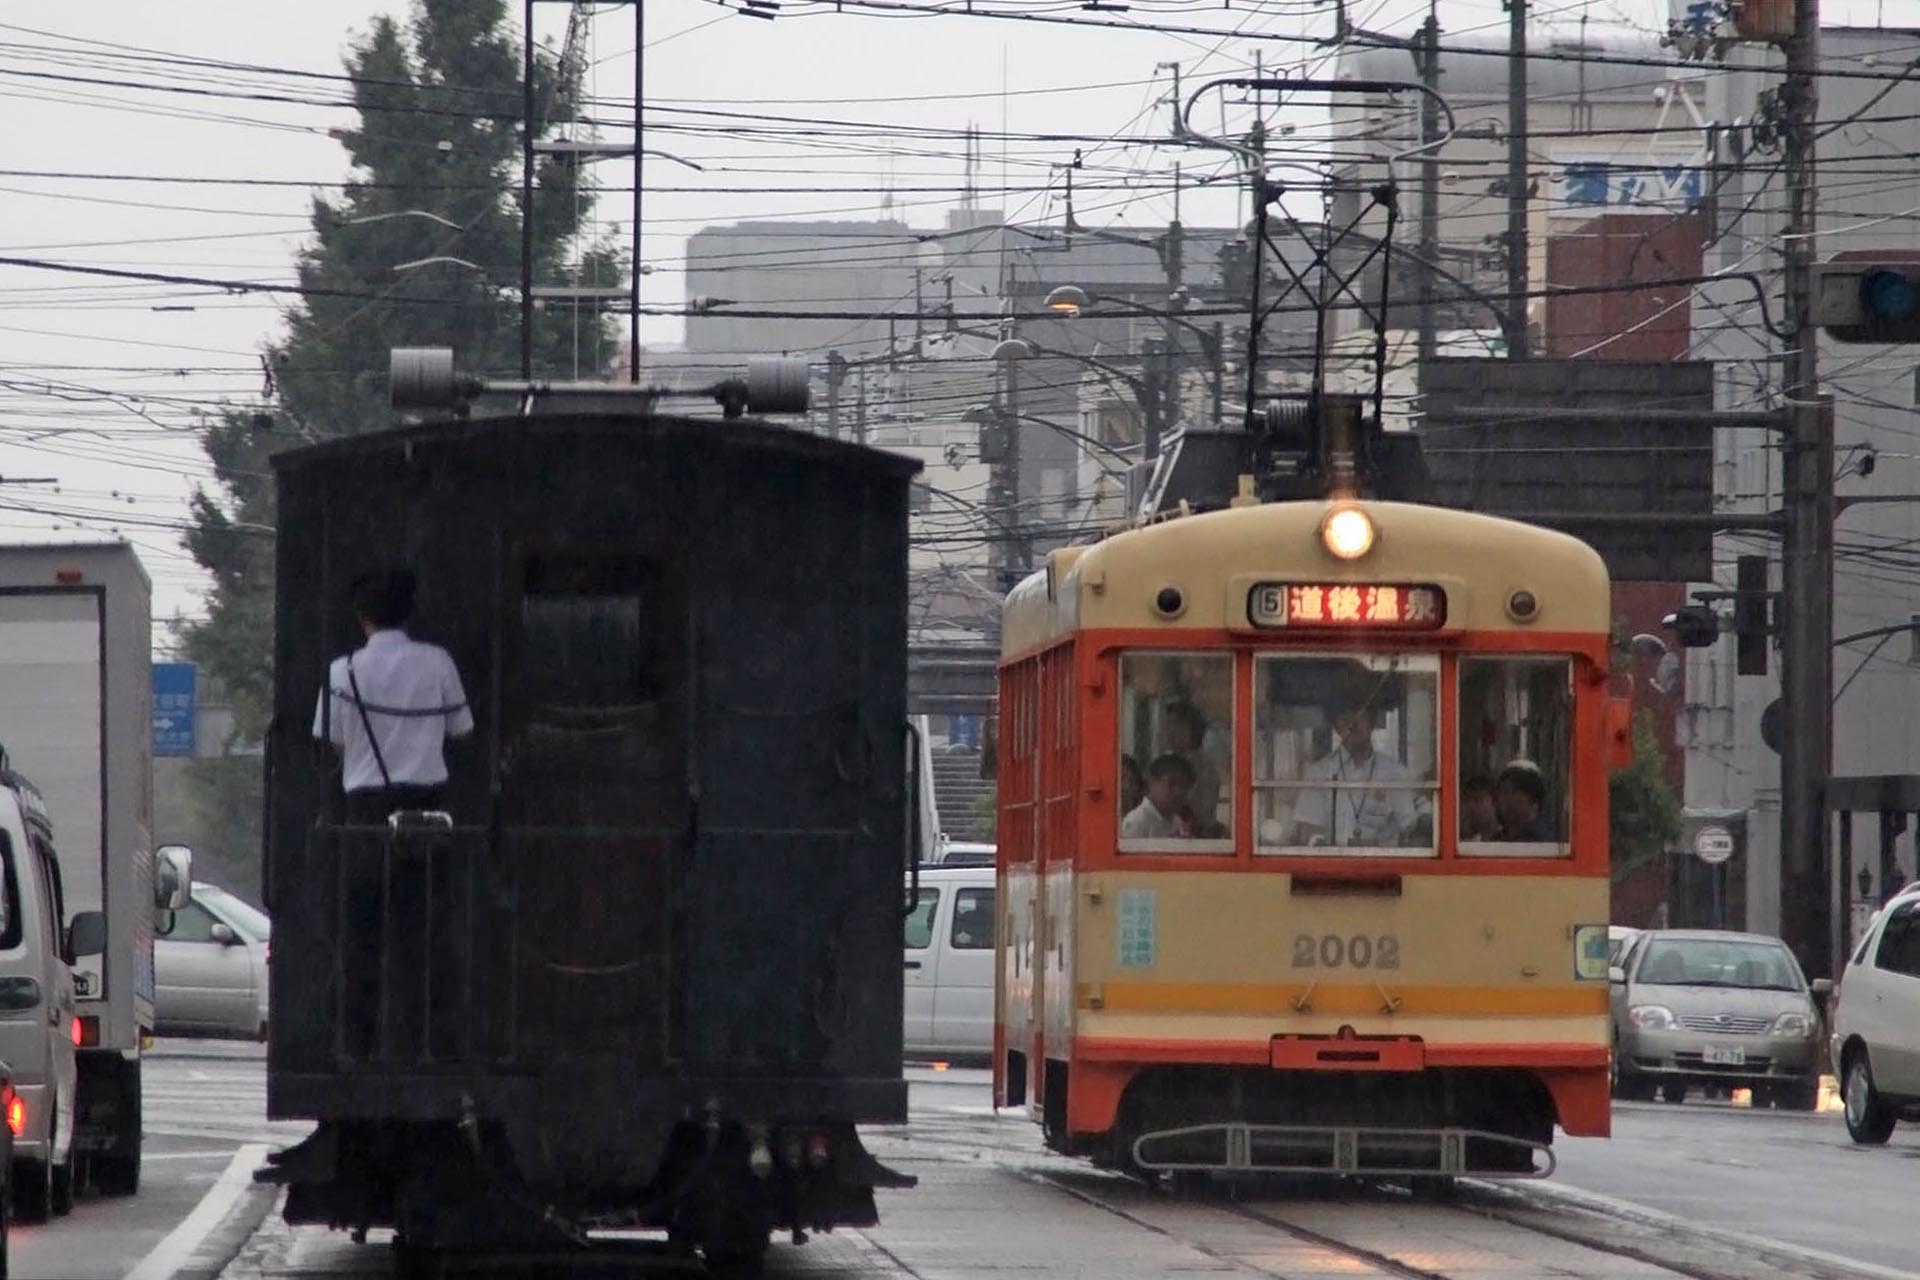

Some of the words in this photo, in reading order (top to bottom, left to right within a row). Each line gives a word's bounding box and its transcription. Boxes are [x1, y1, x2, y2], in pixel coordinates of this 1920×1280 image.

[1264, 590, 1279, 613] 5
[1291, 586, 1436, 621] 道後温泉
[1291, 933, 1400, 969] 2002
